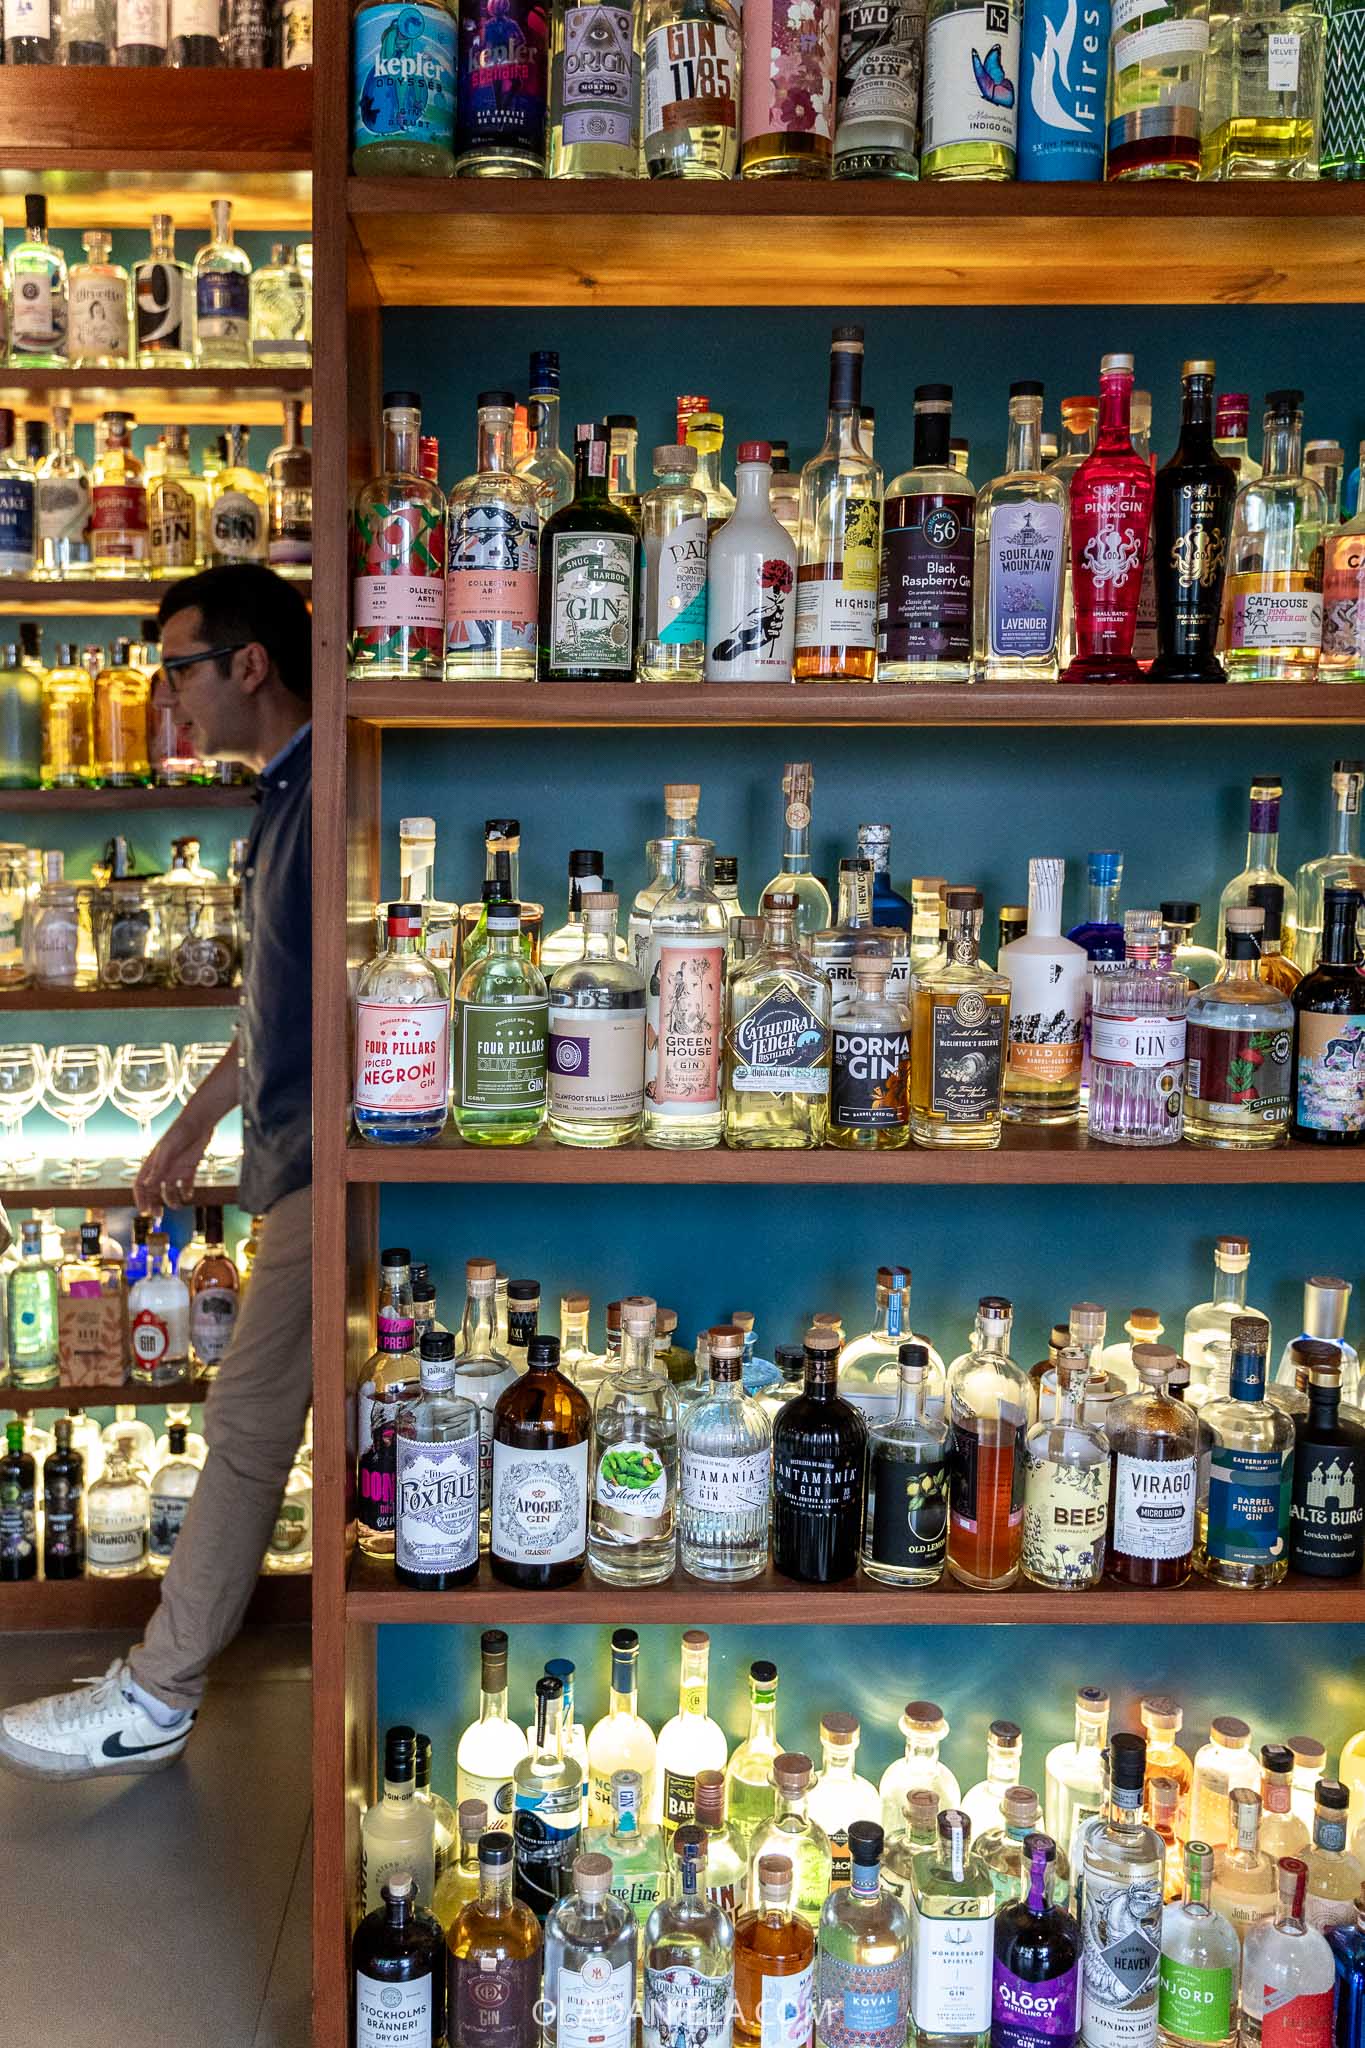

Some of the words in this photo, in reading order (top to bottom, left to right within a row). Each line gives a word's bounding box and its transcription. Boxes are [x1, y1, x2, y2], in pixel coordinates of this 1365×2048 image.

[849, 6, 889, 30] TWO
[667, 22, 716, 61] GIN
[1273, 37, 1296, 46] BLUE
[1270, 48, 1299, 57] VELVET
[565, 52, 633, 76] ORIGIN
[863, 63, 901, 76] GIN
[1075, 8, 1100, 121] Fires
[969, 122, 1001, 132] INDIGO
[1085, 501, 1117, 513] PINK
[1119, 501, 1142, 513] GIN
[1190, 501, 1214, 512] GIN
[152, 522, 192, 547] GIN
[933, 519, 956, 544] 56
[999, 548, 1054, 563] SOURLAND
[566, 557, 589, 571] SNUG
[927, 562, 956, 574] Black
[1002, 560, 1051, 573] MOUNTAIN
[593, 571, 625, 583] HARBOR
[902, 574, 958, 588] Raspberry
[418, 596, 435, 604] ARTS
[1247, 596, 1309, 609] CATHOUSE
[566, 597, 623, 621] GIN
[1268, 608, 1288, 616] PINK
[1000, 617, 1048, 630] LAVENDER
[1267, 614, 1295, 622] PEPPER
[1295, 614, 1308, 622] GIN
[739, 1015, 817, 1050] CATHEDRAL
[365, 1040, 388, 1055] FOUR
[393, 1040, 436, 1055] PILLARS
[477, 1040, 504, 1055] FOUR
[509, 1038, 545, 1055] PILLARS
[665, 1036, 712, 1047] GREEN
[1135, 1035, 1166, 1057] GIN
[666, 1047, 713, 1057] HOUSE
[751, 1031, 797, 1067] LEDGE
[758, 1047, 796, 1063] DISTILLERY
[1016, 1048, 1057, 1057] WILD
[364, 1059, 392, 1068] SPICED
[680, 1061, 698, 1070] GIN
[848, 1055, 899, 1080] GIN
[364, 1061, 436, 1086] NEGRONI
[420, 1078, 435, 1089] GIN
[527, 1079, 544, 1092] GIN
[585, 1095, 606, 1103] STILLS
[1263, 1108, 1289, 1121] GIN
[140, 1336, 156, 1353] GIN
[1233, 1456, 1259, 1465] EASTERN
[1131, 1472, 1191, 1494] VIRAGO
[699, 1489, 719, 1501] GIN
[800, 1485, 821, 1497] GIN
[514, 1497, 563, 1514] APOGEE
[1237, 1497, 1272, 1505] BARREL
[1140, 1507, 1163, 1518] MICRO
[1163, 1507, 1183, 1518] BATCH
[1232, 1504, 1275, 1513] FINISHED
[1245, 1512, 1263, 1521] GIN
[1331, 1507, 1364, 1526] BURG
[1303, 1529, 1329, 1540] London
[908, 1545, 926, 1554] OLD
[619, 1790, 634, 1807] GIN
[1114, 1956, 1151, 1971] HEAVEN
[1160, 1975, 1214, 2004] NJORD
[852, 1994, 893, 2007] KOVAL
[360, 2002, 427, 2020] STOCKHOLMS
[1003, 2000, 1042, 2018] DISTILLING
[367, 2016, 418, 2031] BRÄNNERI
[479, 2009, 500, 2026] GIN
[1094, 2015, 1136, 2032] LONDON
[375, 2033, 393, 2042] DRY
[393, 2033, 409, 2042] GIN
[1016, 2039, 1036, 2048] GIN
